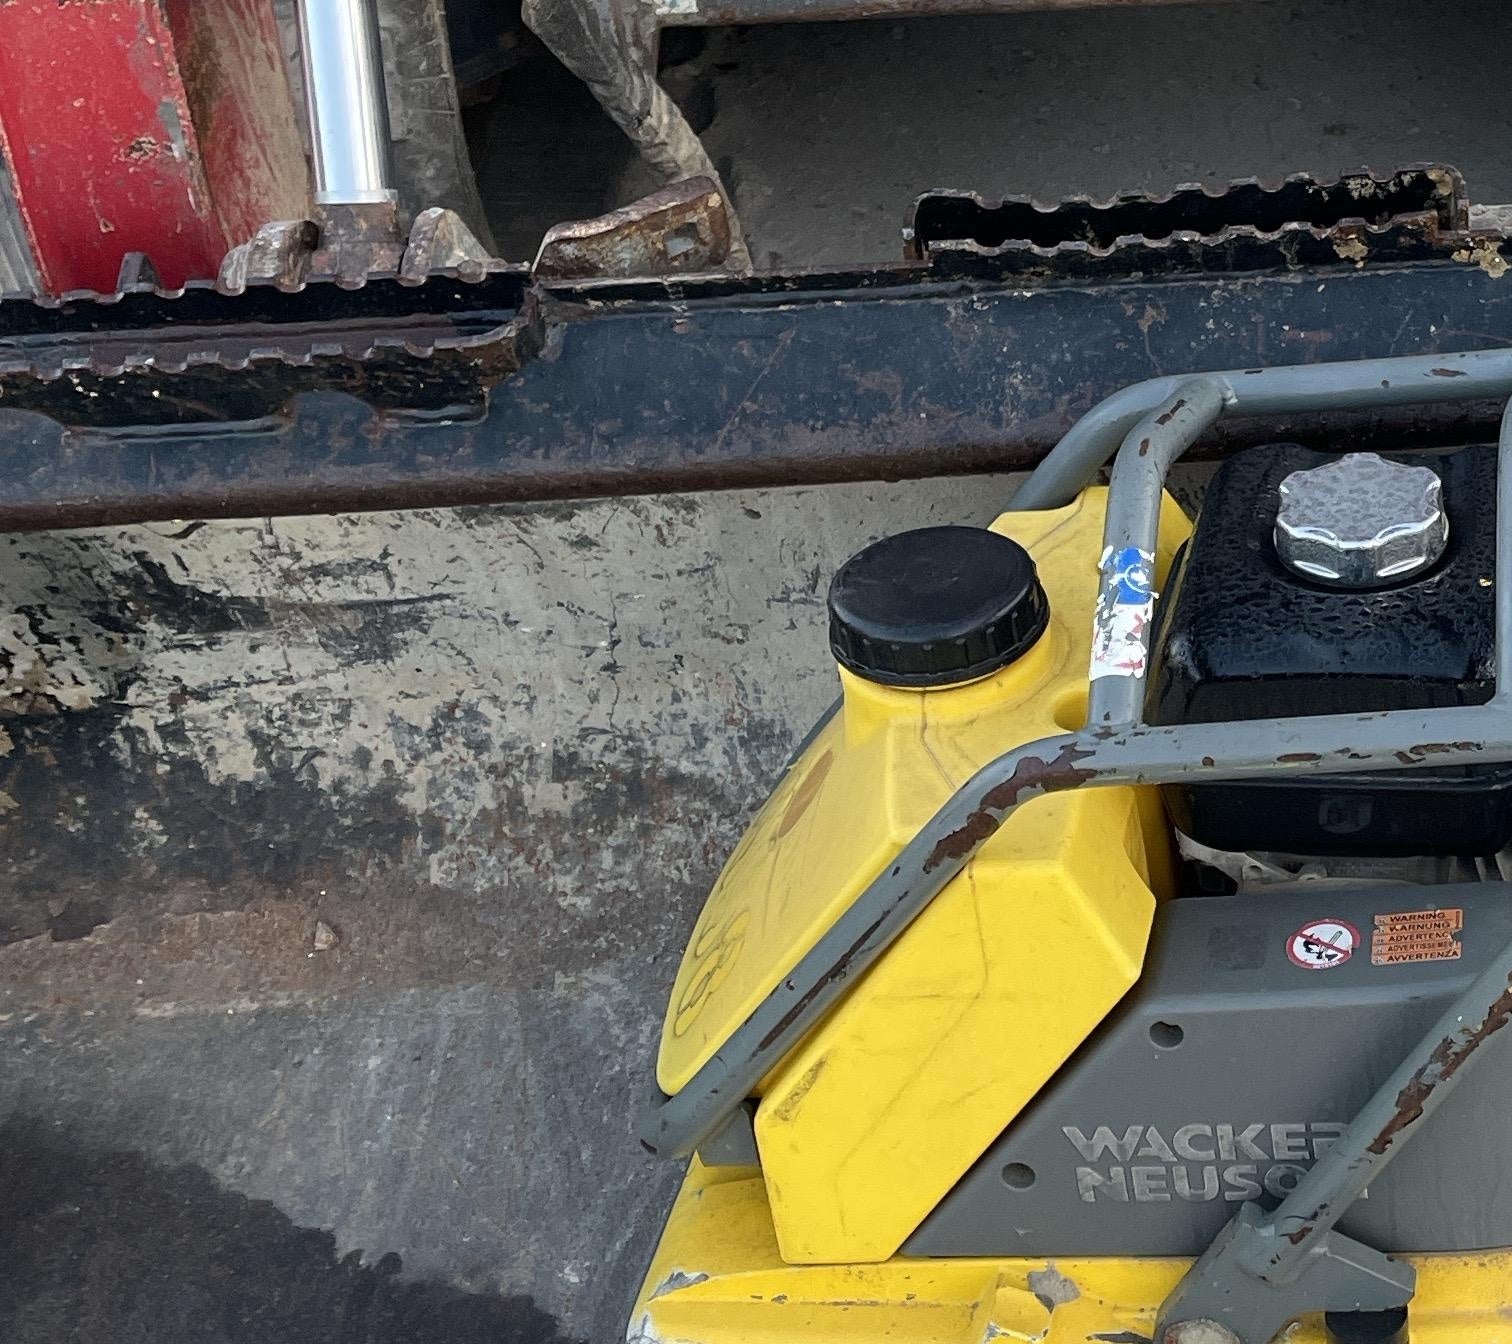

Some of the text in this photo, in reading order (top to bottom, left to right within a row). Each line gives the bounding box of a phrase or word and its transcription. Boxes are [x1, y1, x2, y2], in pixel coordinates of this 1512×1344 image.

[1390, 912, 1446, 923] WARNING
[1388, 931, 1450, 943] ADVERTENC
[1386, 949, 1459, 962] AVVERTENZA
[1075, 1164, 1369, 1203] NEUSO
